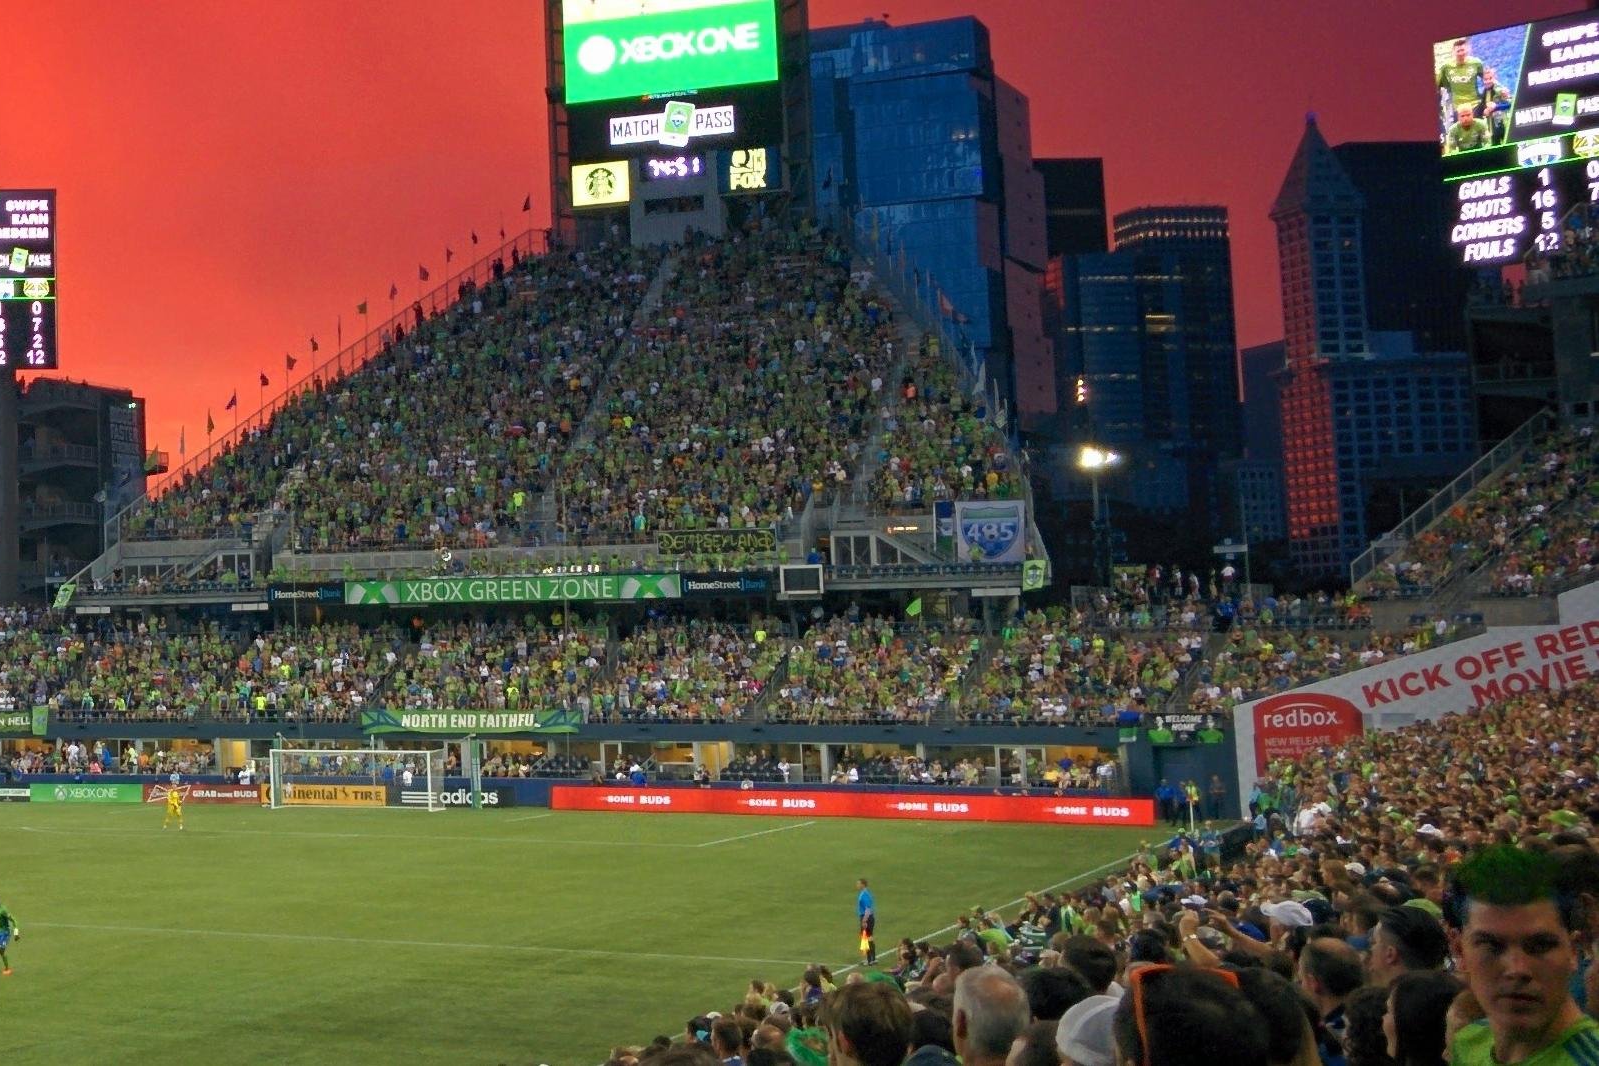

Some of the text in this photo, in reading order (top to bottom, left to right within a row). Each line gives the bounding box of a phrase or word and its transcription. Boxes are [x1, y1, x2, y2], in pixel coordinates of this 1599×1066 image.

[620, 22, 759, 64] XBOX ONE
[612, 111, 732, 139] MATCH PASS
[730, 172, 766, 190] FOX
[1459, 176, 1512, 200] GOALS
[1537, 168, 1549, 187] 1
[5, 199, 49, 211] SWIPE
[1460, 197, 1512, 220] SHOTS
[1531, 189, 1555, 210] 16
[11, 213, 49, 225] EARN
[1452, 211, 1555, 243] CORNERS 5
[1464, 232, 1558, 262] FOULS 12
[32, 301, 42, 315] 0
[32, 318, 42, 332] 7
[32, 334, 43, 349] 2
[26, 349, 45, 364] 12
[968, 522, 1014, 541] 485
[407, 578, 613, 601] XBOX GREEN ZONE
[688, 580, 741, 590] HomeStreet
[274, 590, 320, 599] HomeStreet
[1362, 663, 1453, 709] KICK
[1454, 641, 1526, 681] OFF
[1471, 654, 1591, 709] MOVIE
[8, 716, 31, 726] HELL
[402, 714, 447, 728] NORTH
[451, 714, 476, 728] END
[1165, 715, 1203, 724] WELCOME
[1263, 705, 1338, 728] redbox
[1172, 723, 1195, 731] HOME
[1264, 737, 1287, 747] NEW
[69, 788, 119, 799] XBOX ONE
[192, 790, 217, 798] GRAB
[234, 790, 258, 798] BUDS
[352, 790, 382, 801] TIRE
[607, 795, 672, 805] SOME BUDS
[748, 798, 816, 809] SOME BUDS
[897, 802, 969, 813] SOME BUDS
[1054, 806, 1130, 817] SOME BUDS
